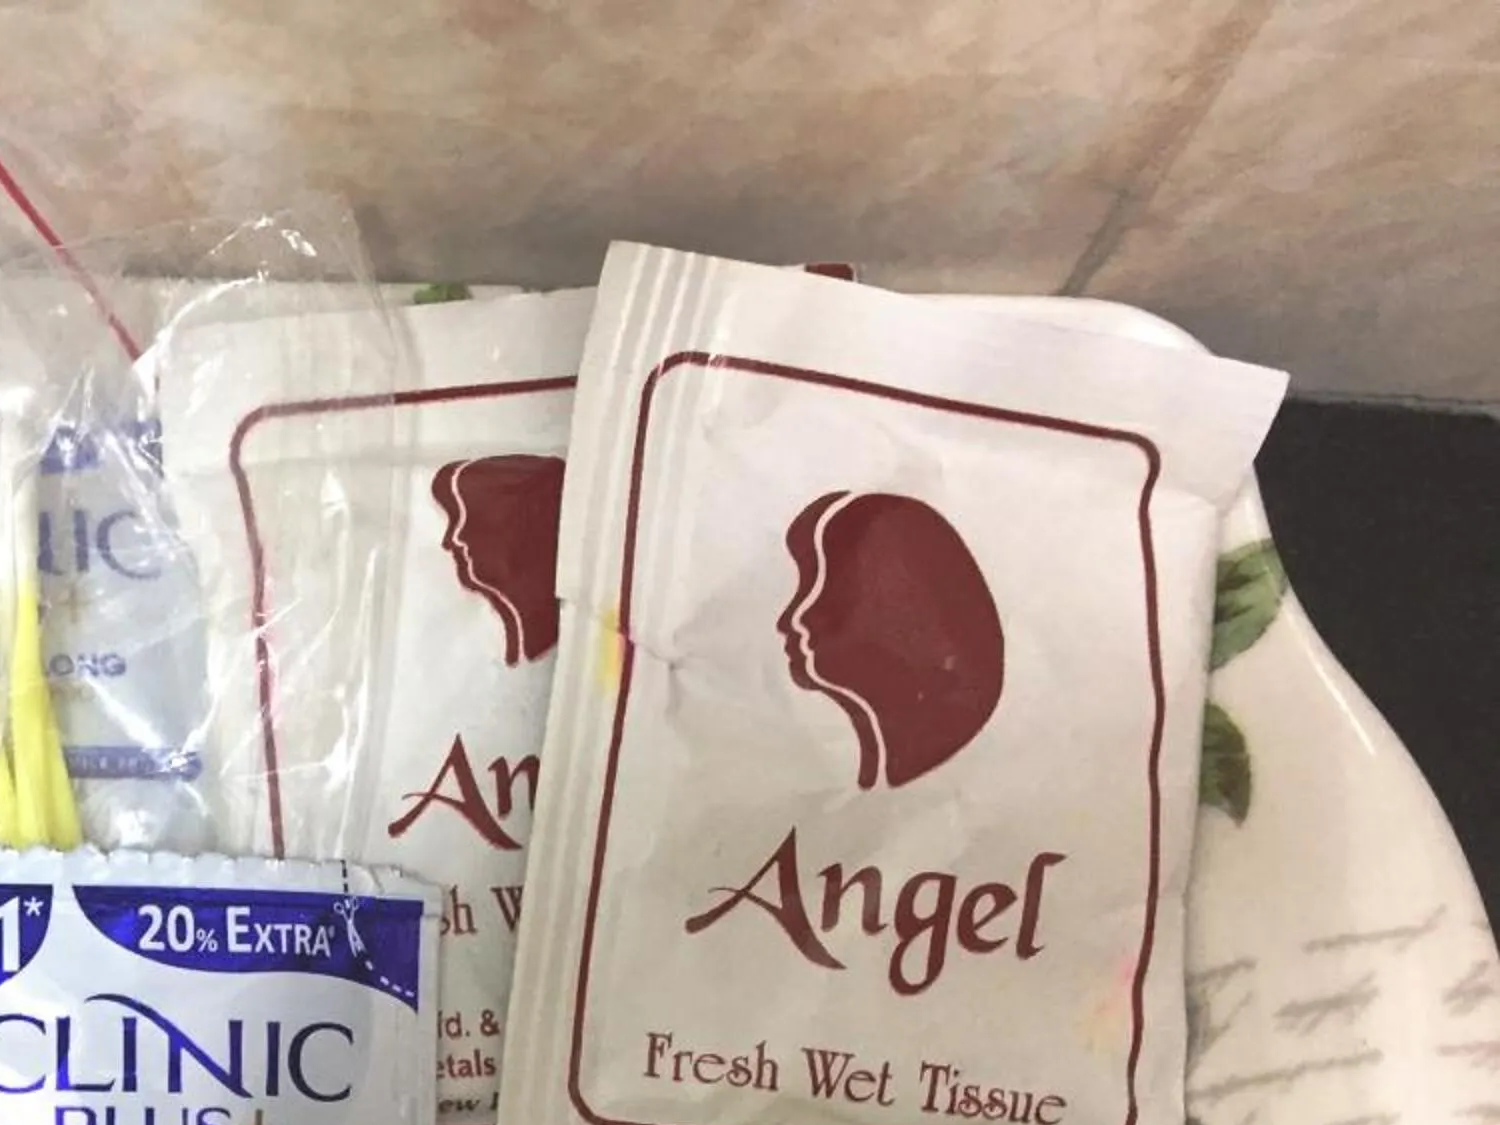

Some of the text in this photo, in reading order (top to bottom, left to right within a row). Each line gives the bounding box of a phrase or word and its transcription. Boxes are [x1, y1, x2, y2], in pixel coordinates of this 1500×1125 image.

[137, 904, 219, 953] 20%
[685, 826, 1067, 996] Angel
[644, 1031, 779, 1091] Fresh
[802, 1047, 896, 1105] Wet
